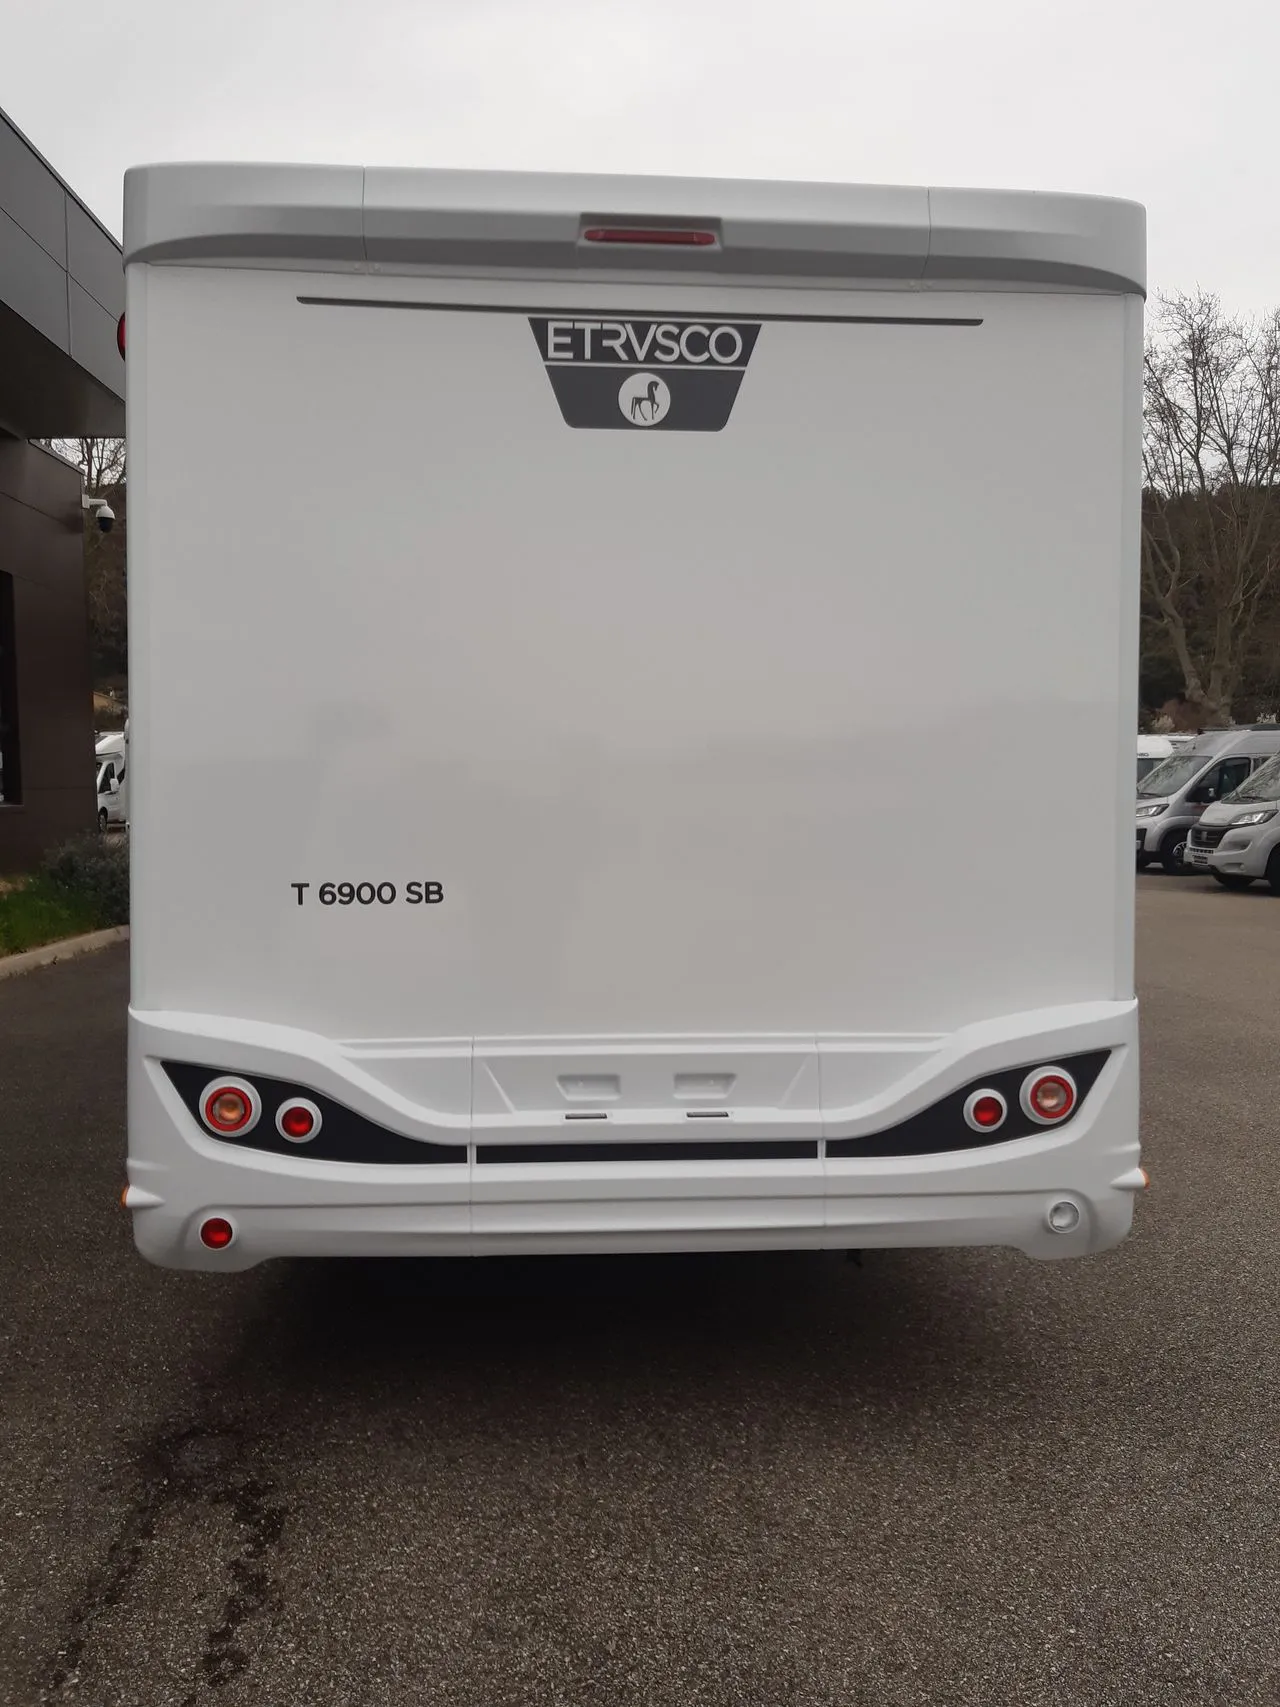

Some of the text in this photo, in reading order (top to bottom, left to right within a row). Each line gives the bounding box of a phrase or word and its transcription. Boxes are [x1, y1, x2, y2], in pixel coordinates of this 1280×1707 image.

[547, 320, 743, 364] ETRVSCO
[290, 881, 445, 906] T 6900 SB
